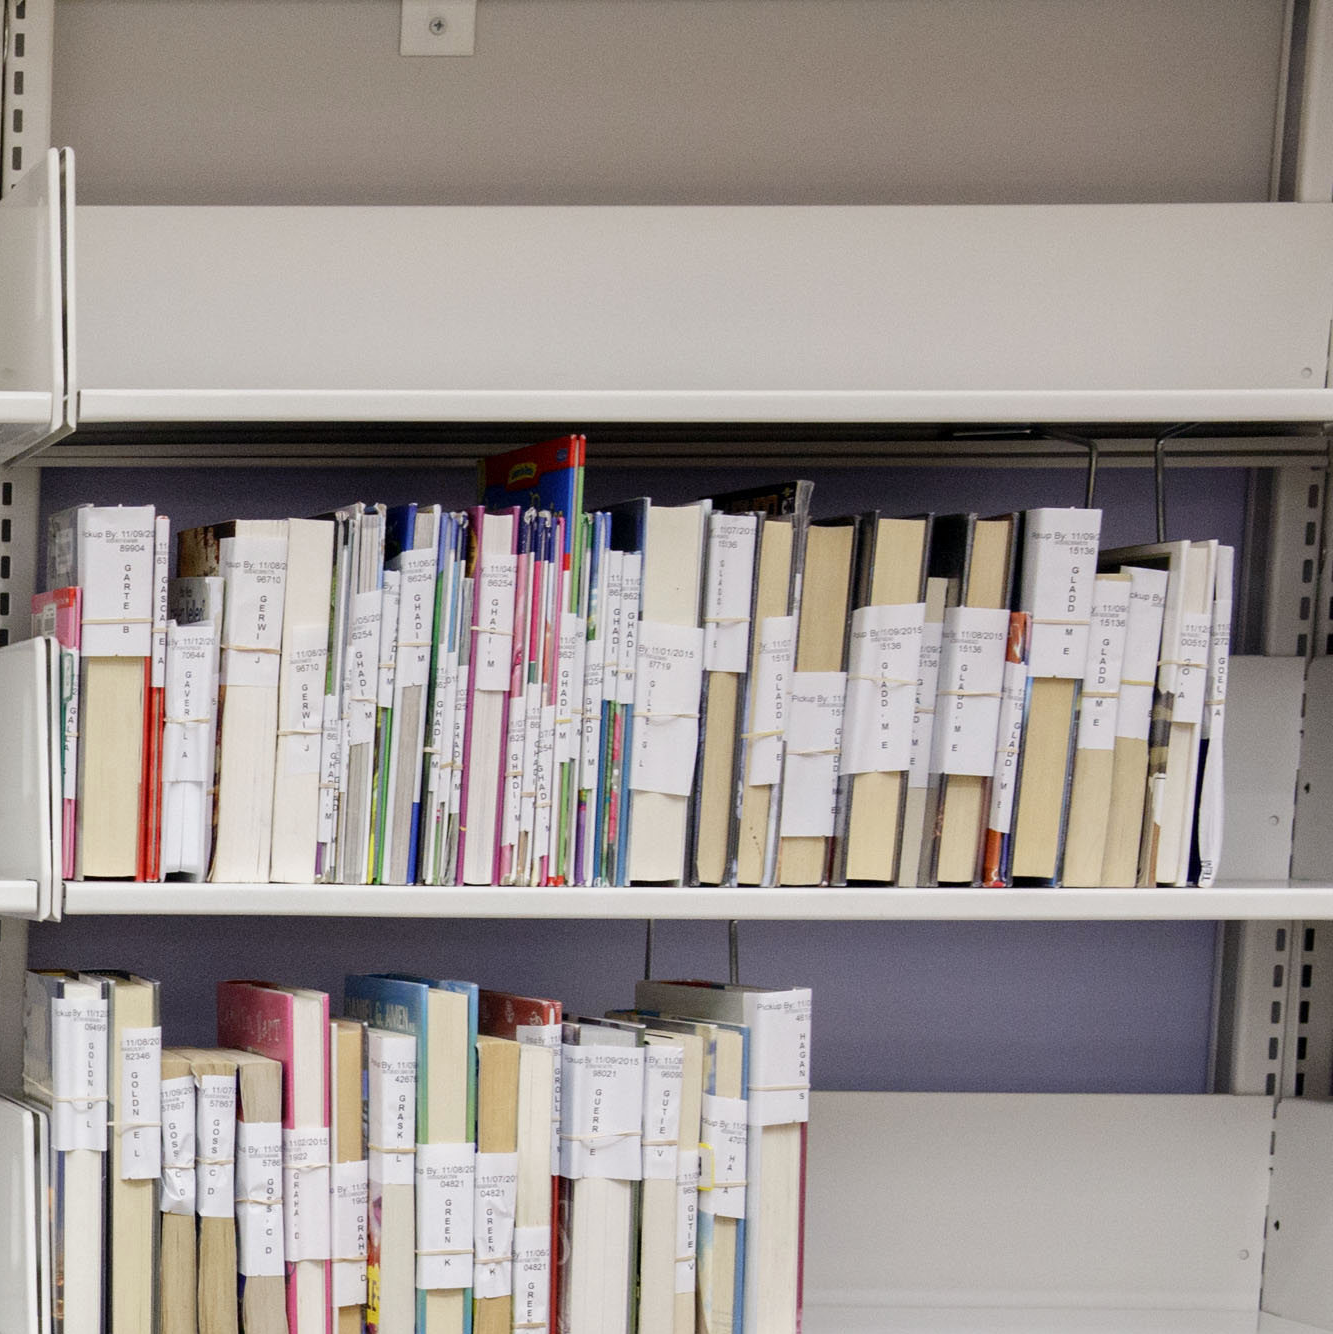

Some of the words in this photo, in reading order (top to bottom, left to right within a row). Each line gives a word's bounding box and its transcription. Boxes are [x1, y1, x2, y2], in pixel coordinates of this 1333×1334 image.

[105, 530, 118, 539] By:
[120, 544, 145, 552] 89904
[1069, 546, 1094, 555] 15136
[256, 576, 281, 584] 96710
[125, 1052, 150, 1060] 82346
[595, 1057, 639, 1065] 11/09/2015
[593, 1070, 616, 1078] 98021
[440, 1180, 464, 1188] 04821
[480, 1189, 505, 1198] 04821
[524, 1263, 546, 1272] 04821
